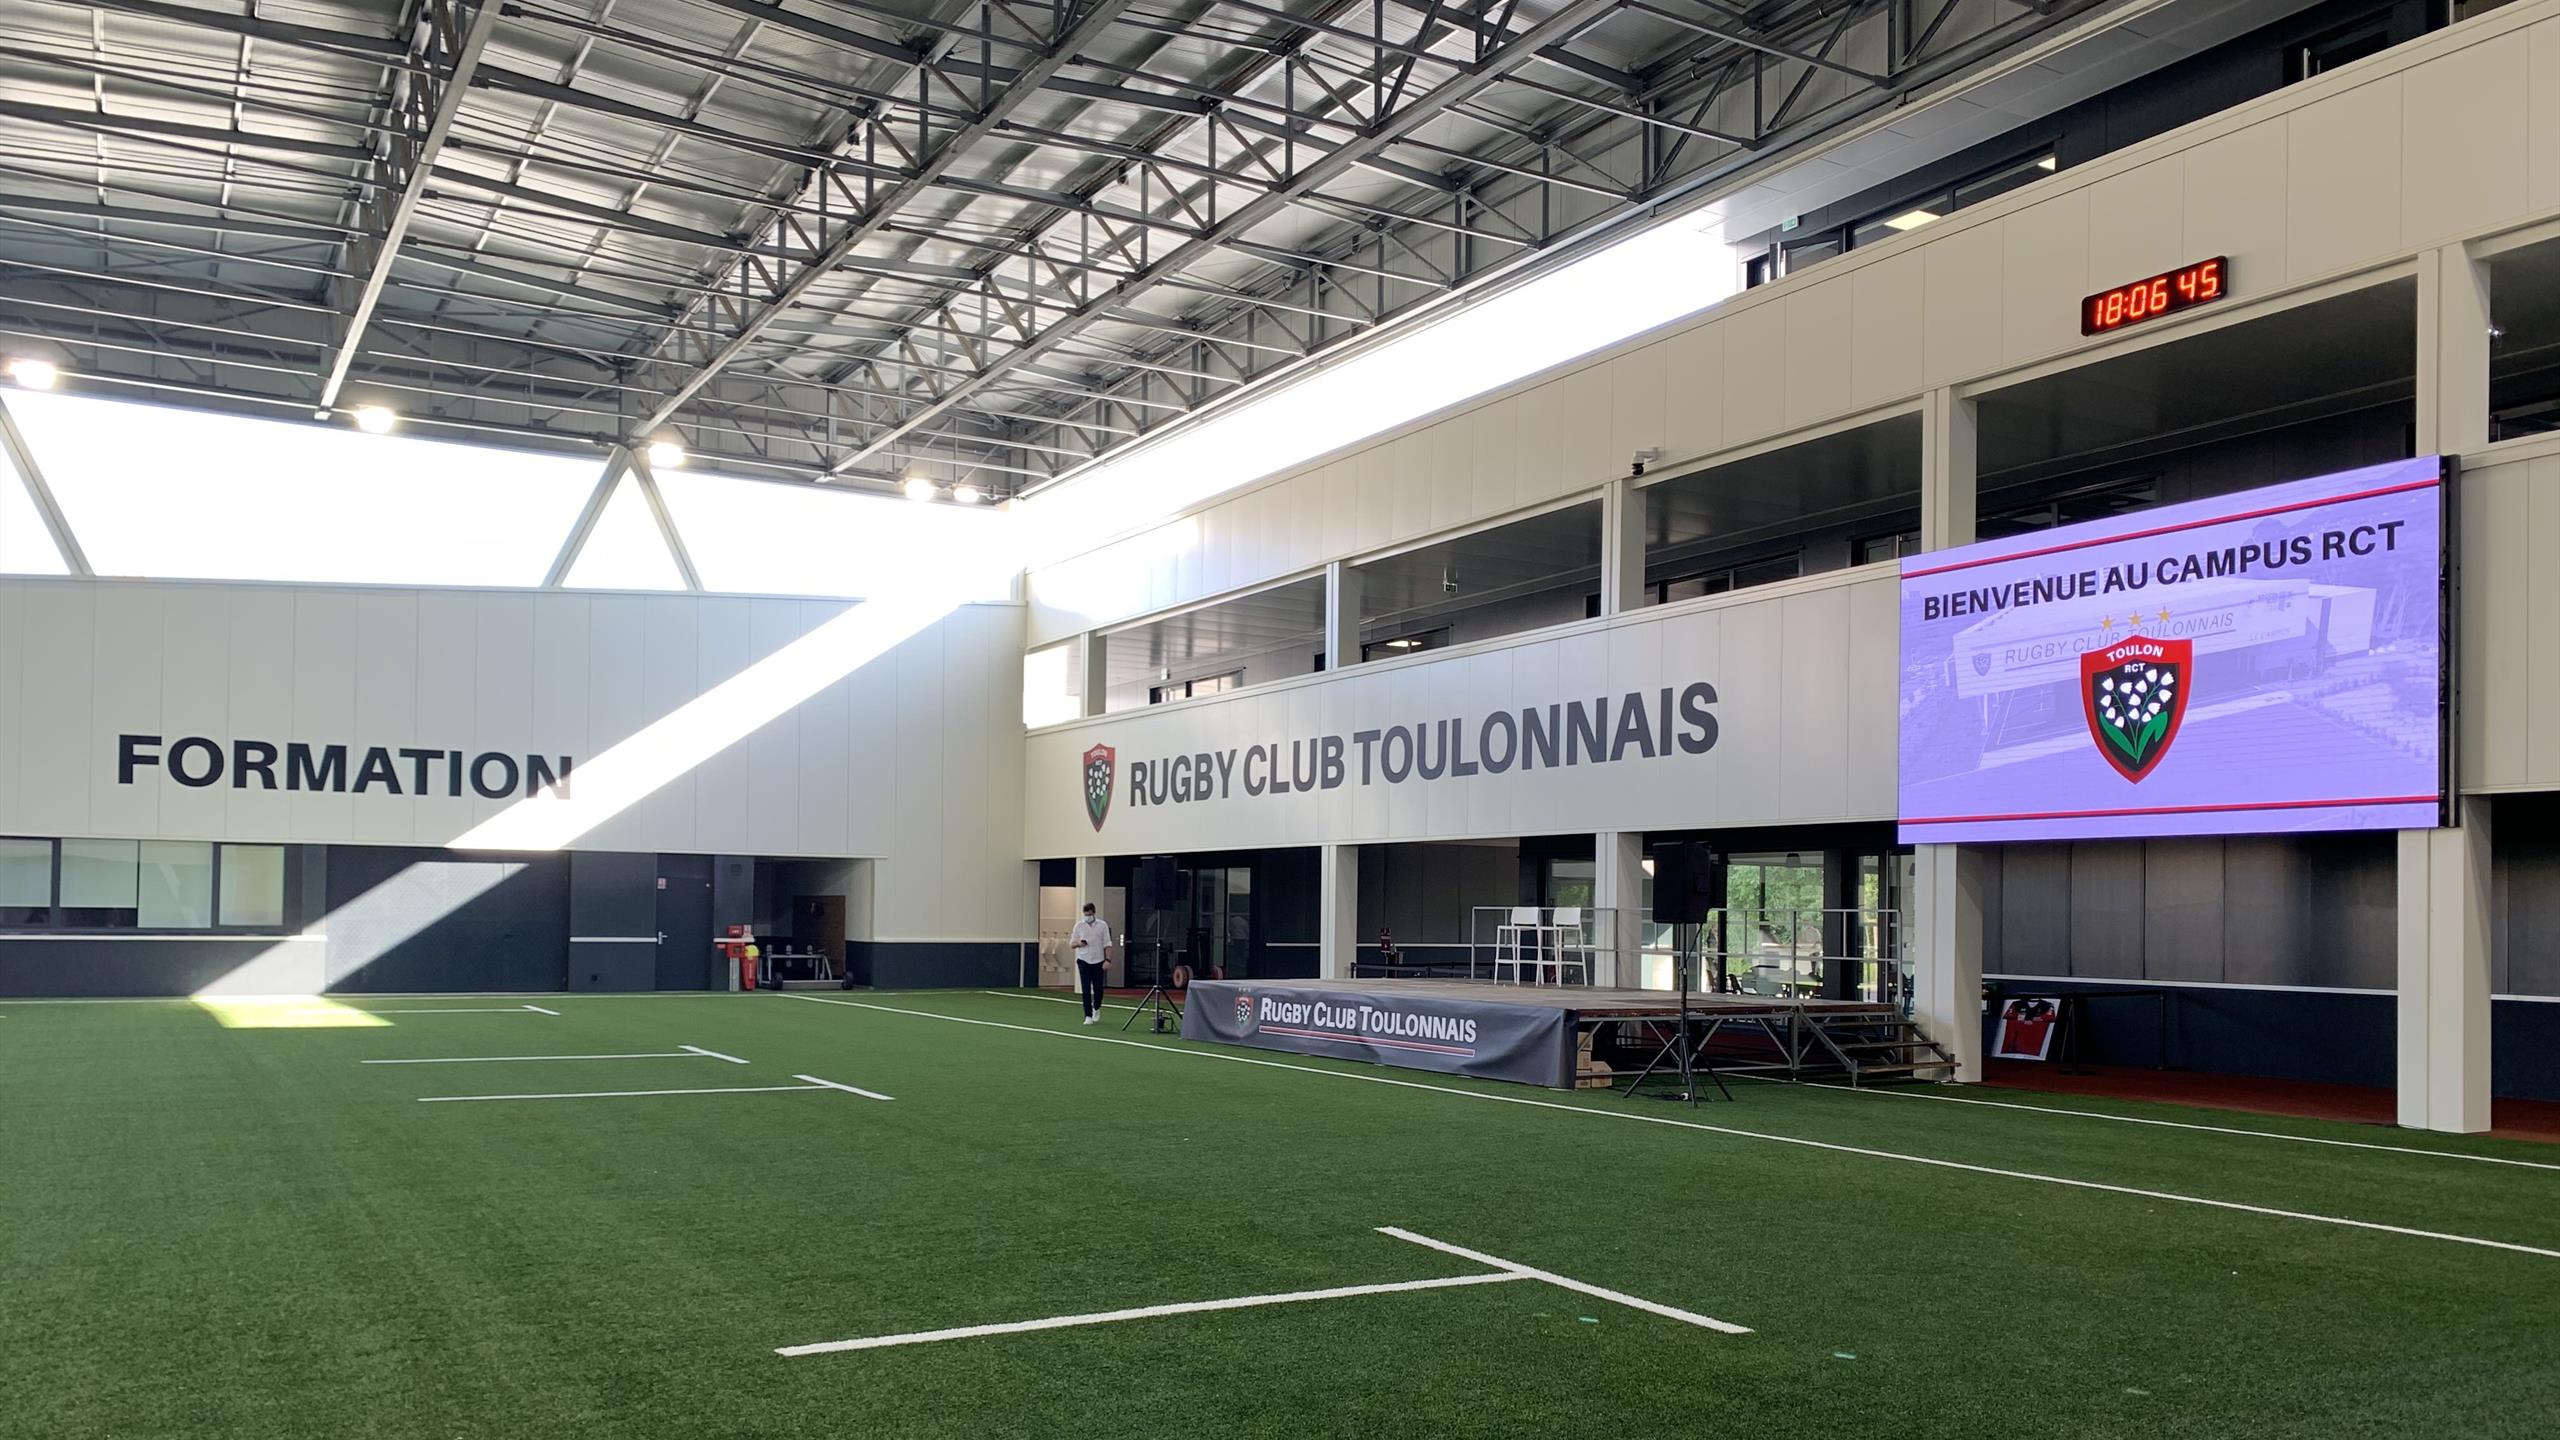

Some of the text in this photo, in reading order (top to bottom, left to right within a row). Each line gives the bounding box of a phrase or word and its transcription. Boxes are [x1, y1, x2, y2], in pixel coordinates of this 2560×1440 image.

[2095, 263, 2218, 326] 18:06 45
[1923, 520, 2404, 621] BIENVENUE AU CAMPUS RCT
[2005, 640, 2068, 665] RUGBY
[2106, 644, 2163, 663] TOULON
[2124, 663, 2146, 673] RCT
[118, 734, 571, 800] FORMATION
[1130, 682, 1719, 807] RUGBY CLUB TOULONNAIS
[1260, 997, 1477, 1043] RUGBY CLUB TOULONNAIS
